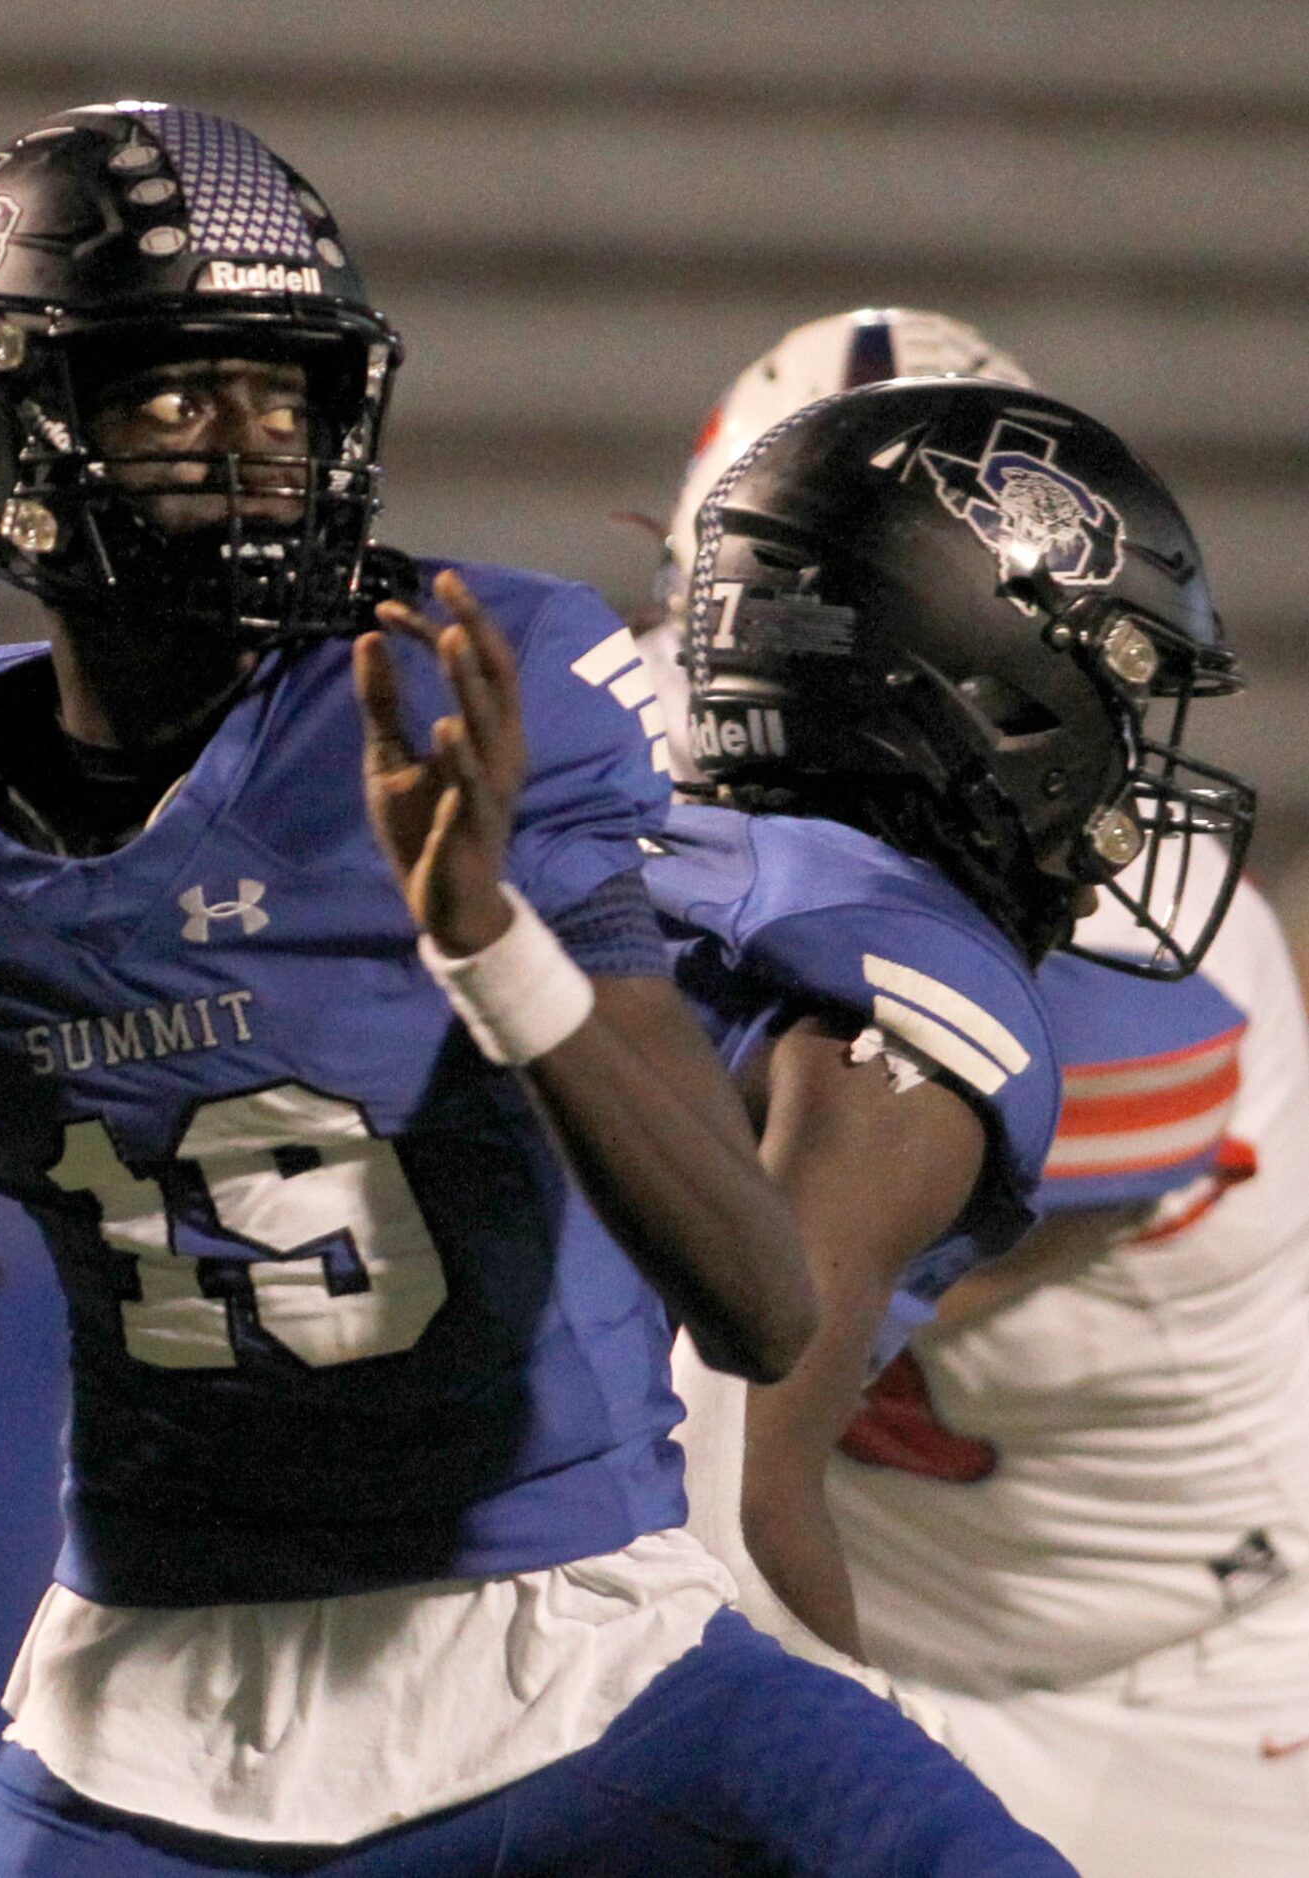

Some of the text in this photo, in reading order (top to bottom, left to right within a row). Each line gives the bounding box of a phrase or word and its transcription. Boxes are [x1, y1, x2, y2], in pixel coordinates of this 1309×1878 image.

[208, 260, 323, 295] Riddell
[712, 583, 743, 648] 7
[26, 991, 252, 1074] SUMMIT
[46, 1082, 449, 1369] 19
